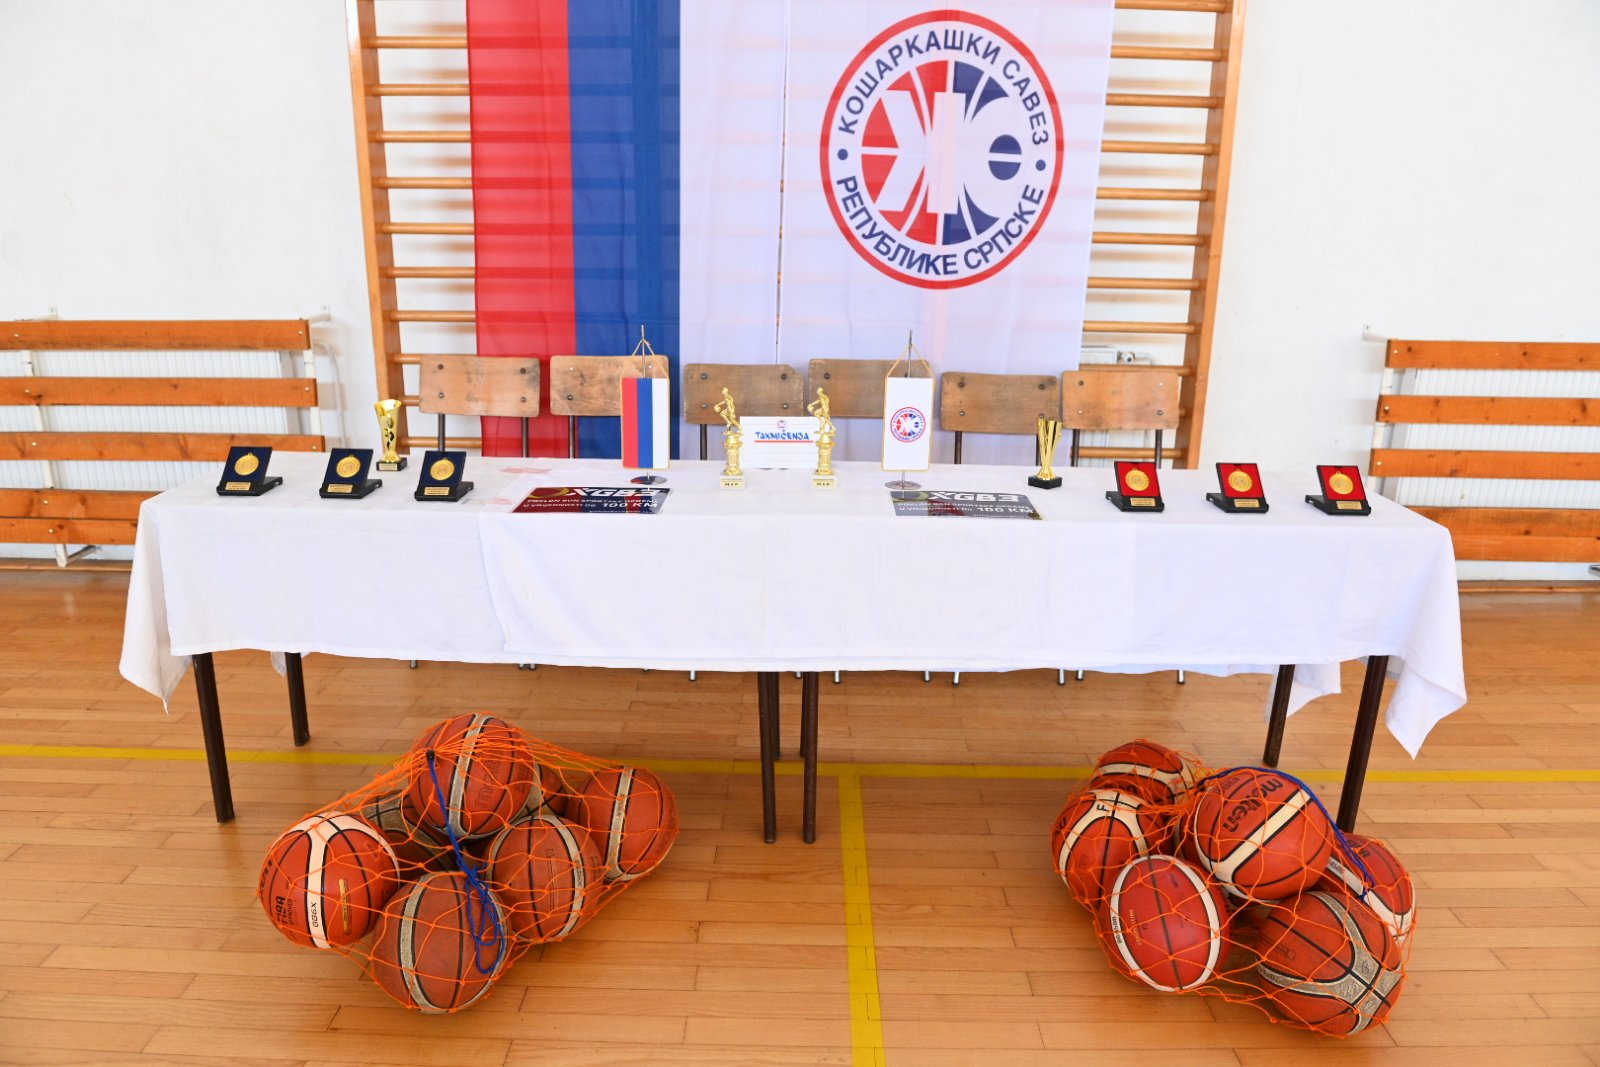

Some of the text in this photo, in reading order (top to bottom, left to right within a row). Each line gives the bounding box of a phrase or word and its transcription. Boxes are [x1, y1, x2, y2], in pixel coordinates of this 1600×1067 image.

[838, 29, 1049, 145] КОШАРКАШКИ САВЕЗ
[836, 175, 1044, 275] РЕПУБЛИКЕ СРПСКЕ
